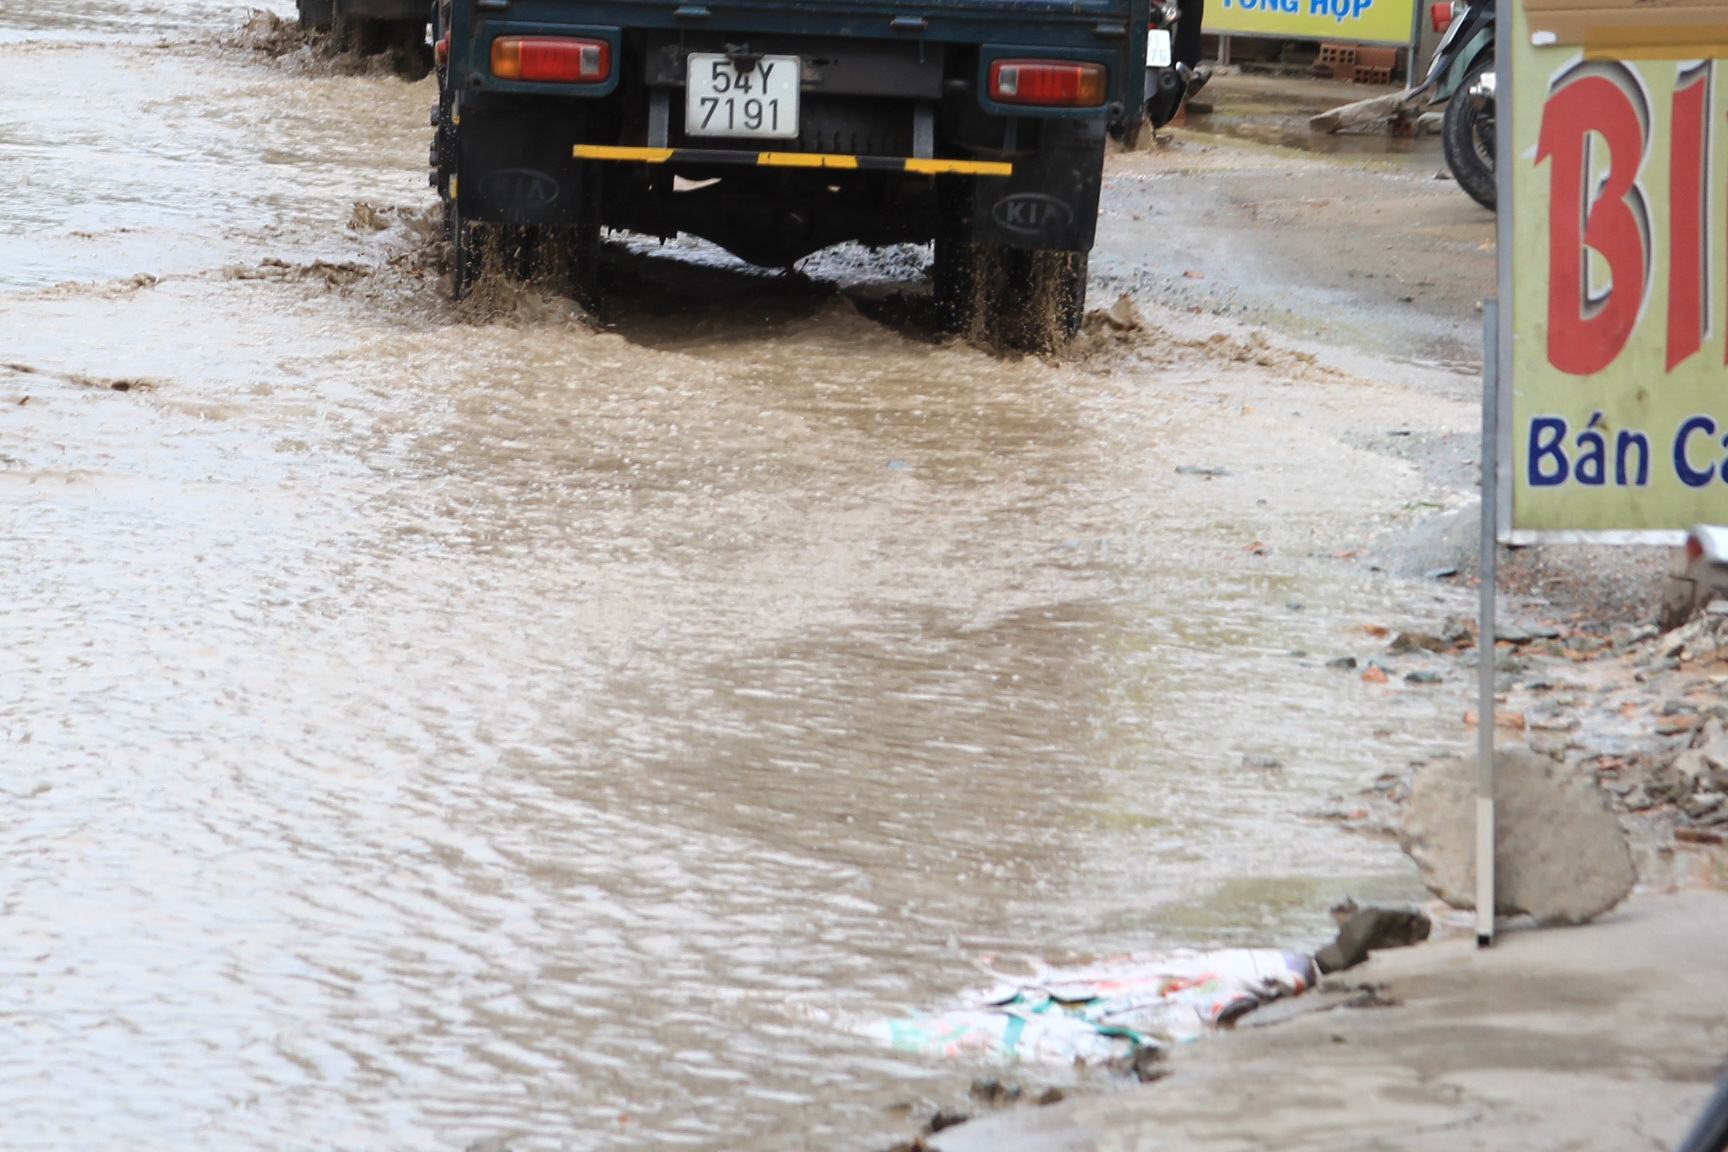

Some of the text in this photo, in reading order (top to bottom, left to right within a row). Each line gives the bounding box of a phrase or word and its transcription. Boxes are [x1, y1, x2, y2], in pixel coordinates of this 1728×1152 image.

[712, 61, 775, 95] 54Y
[700, 97, 779, 131] 7191
[1534, 55, 1728, 376] BI
[1528, 413, 1649, 488] Bán
